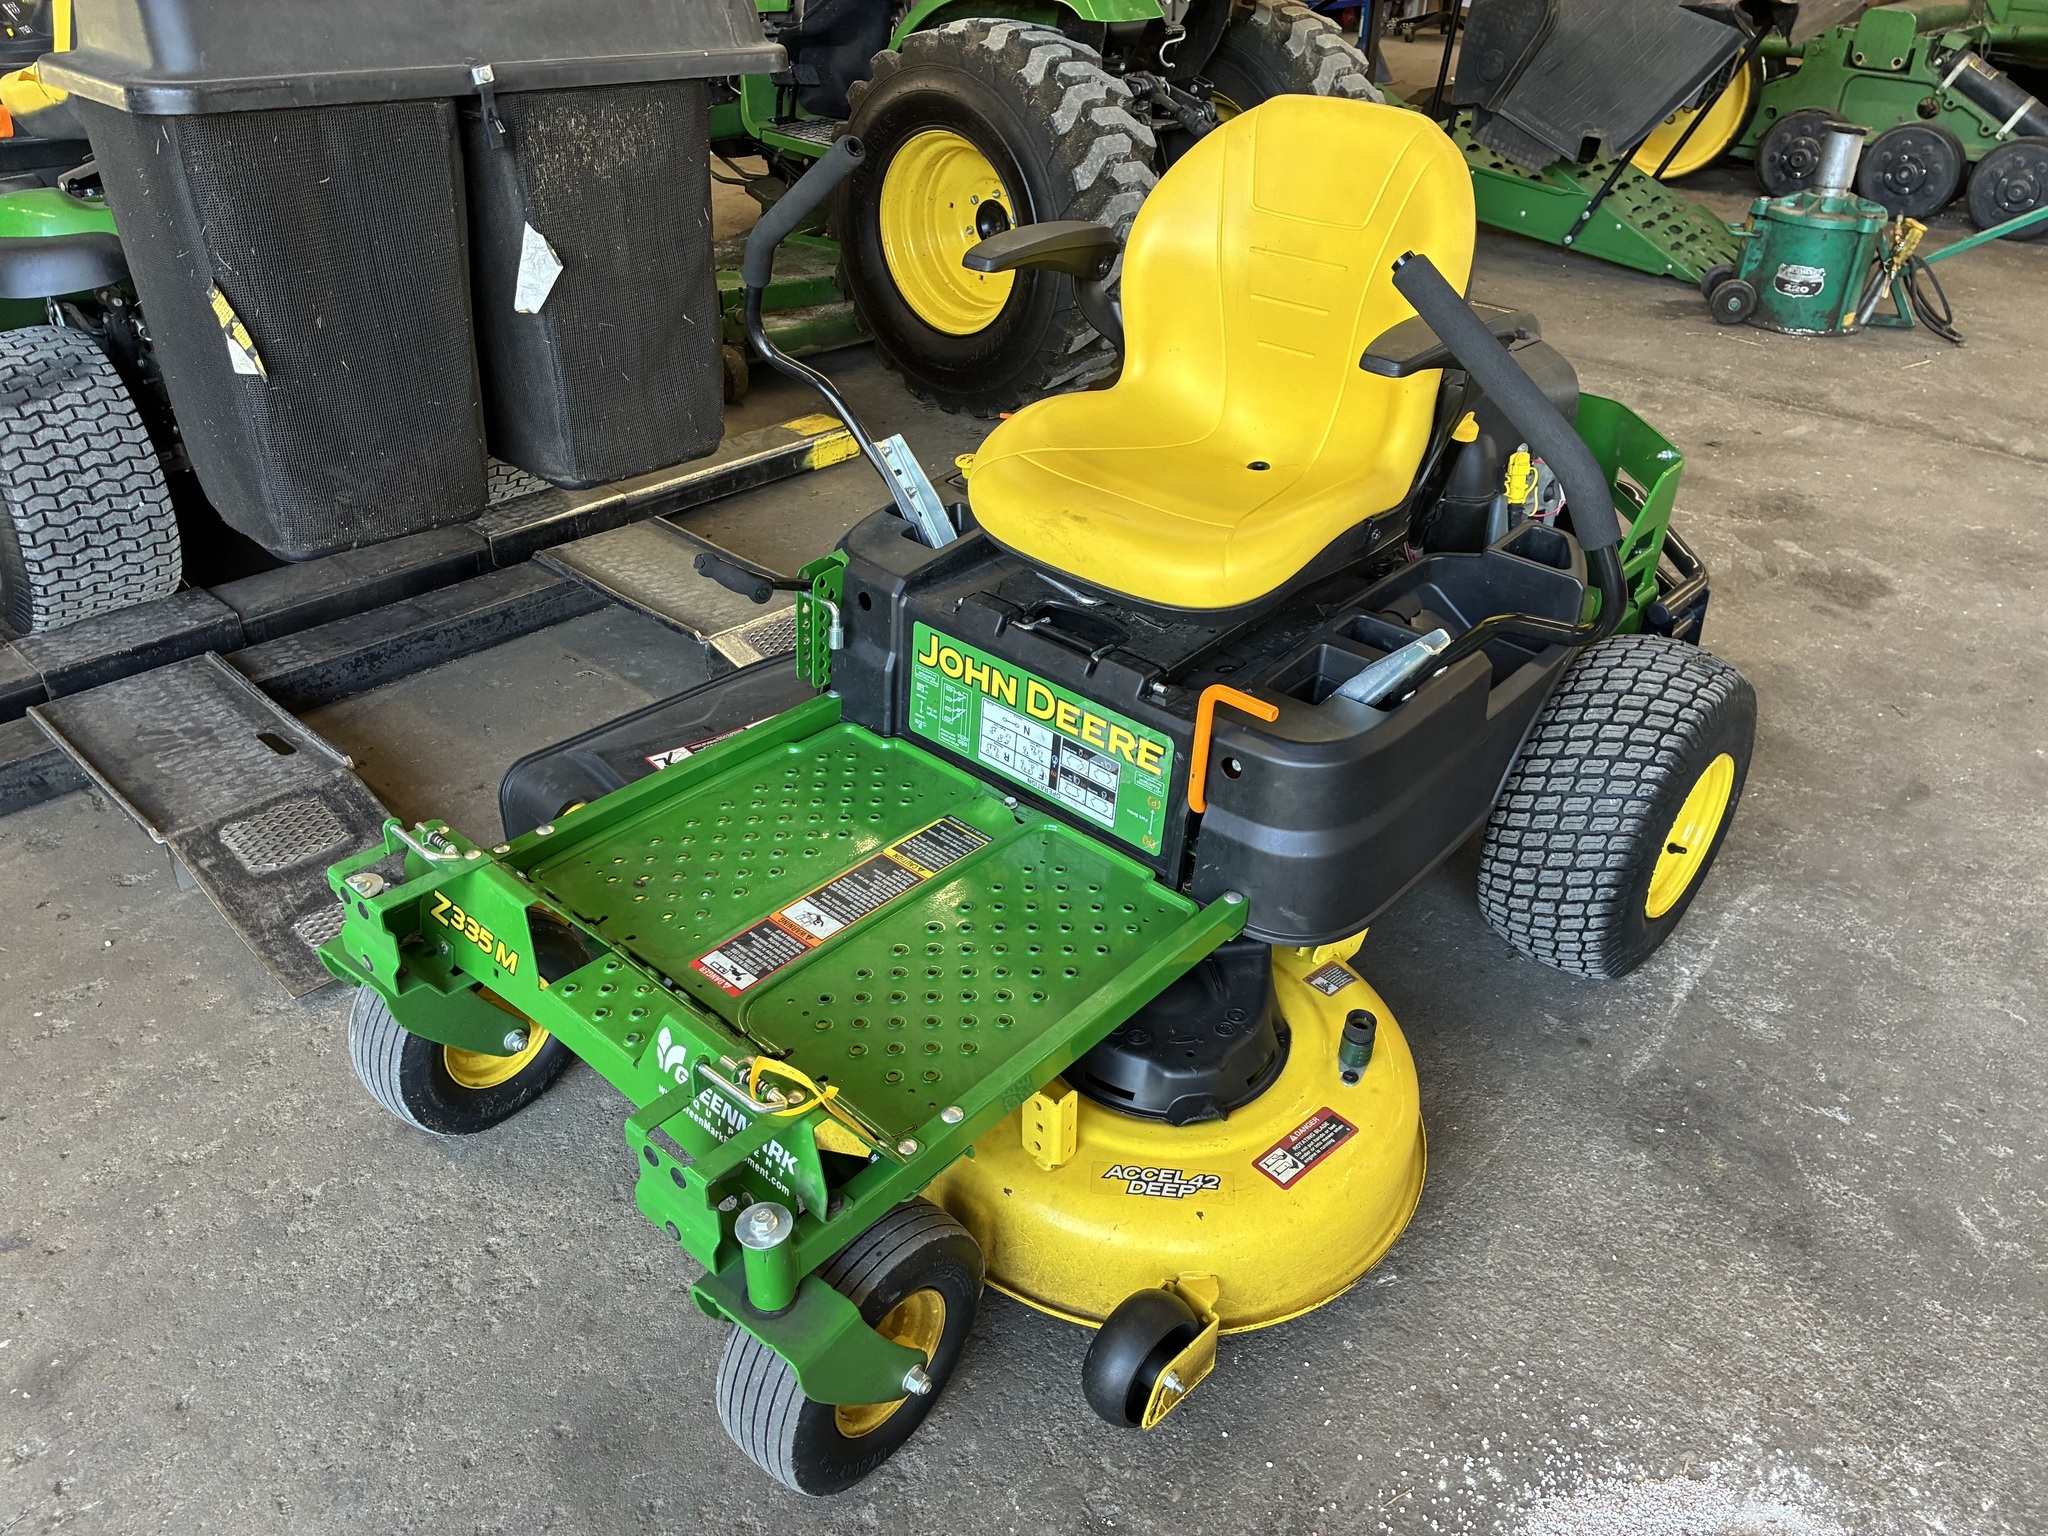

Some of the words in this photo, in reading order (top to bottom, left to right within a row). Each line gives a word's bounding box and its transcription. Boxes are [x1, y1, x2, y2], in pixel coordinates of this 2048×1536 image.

[918, 633, 1018, 707] JOHN
[1025, 677, 1166, 776] DEERE
[1023, 725, 1030, 736] N
[1004, 752, 1010, 762] R
[1026, 777, 1061, 800] OPERATION
[892, 853, 920, 869] CAUTION
[430, 889, 494, 954] Z335
[495, 939, 519, 976] M
[778, 917, 808, 938] WARNING
[698, 966, 726, 986] DANGER
[1292, 1132, 1316, 1150] ROTATING
[1314, 1121, 1330, 1134] BLADE
[1295, 1116, 1320, 1137] DANGER
[1102, 1165, 1188, 1184] ACCEL
[1187, 1174, 1221, 1190] 42
[1126, 1180, 1197, 1198] DEEP
